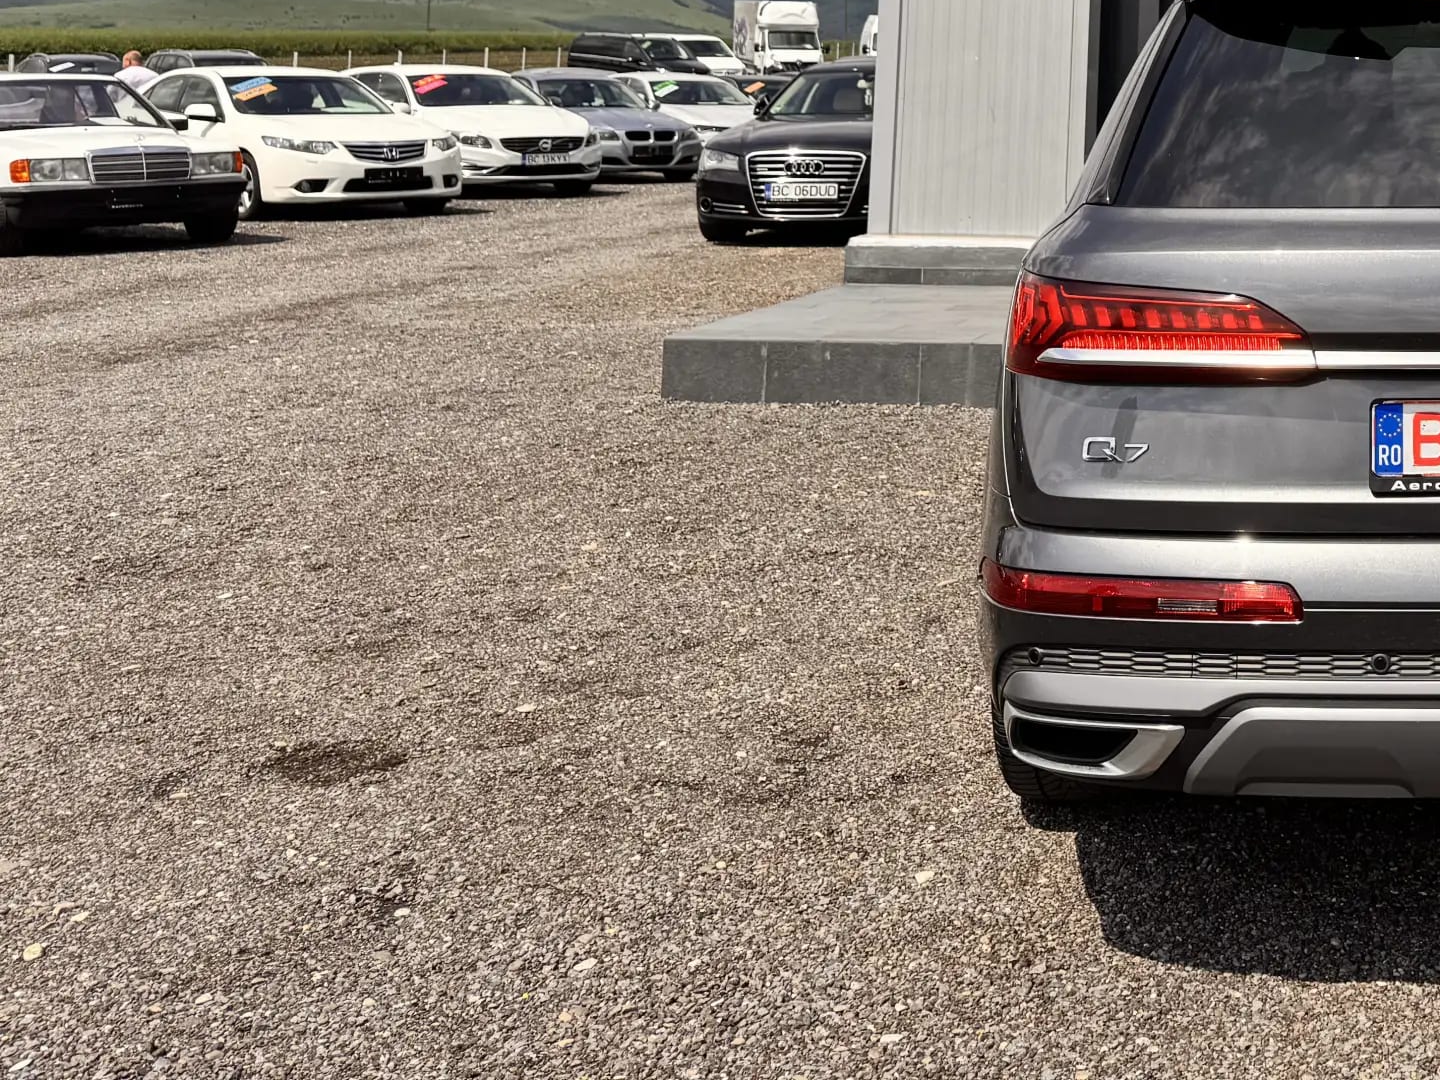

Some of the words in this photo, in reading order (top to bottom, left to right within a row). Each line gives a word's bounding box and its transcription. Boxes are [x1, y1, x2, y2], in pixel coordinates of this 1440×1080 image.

[772, 185, 790, 197] BC
[794, 185, 837, 197] 06DUD
[1082, 436, 1149, 463] Q7
[1378, 444, 1402, 466] RO
